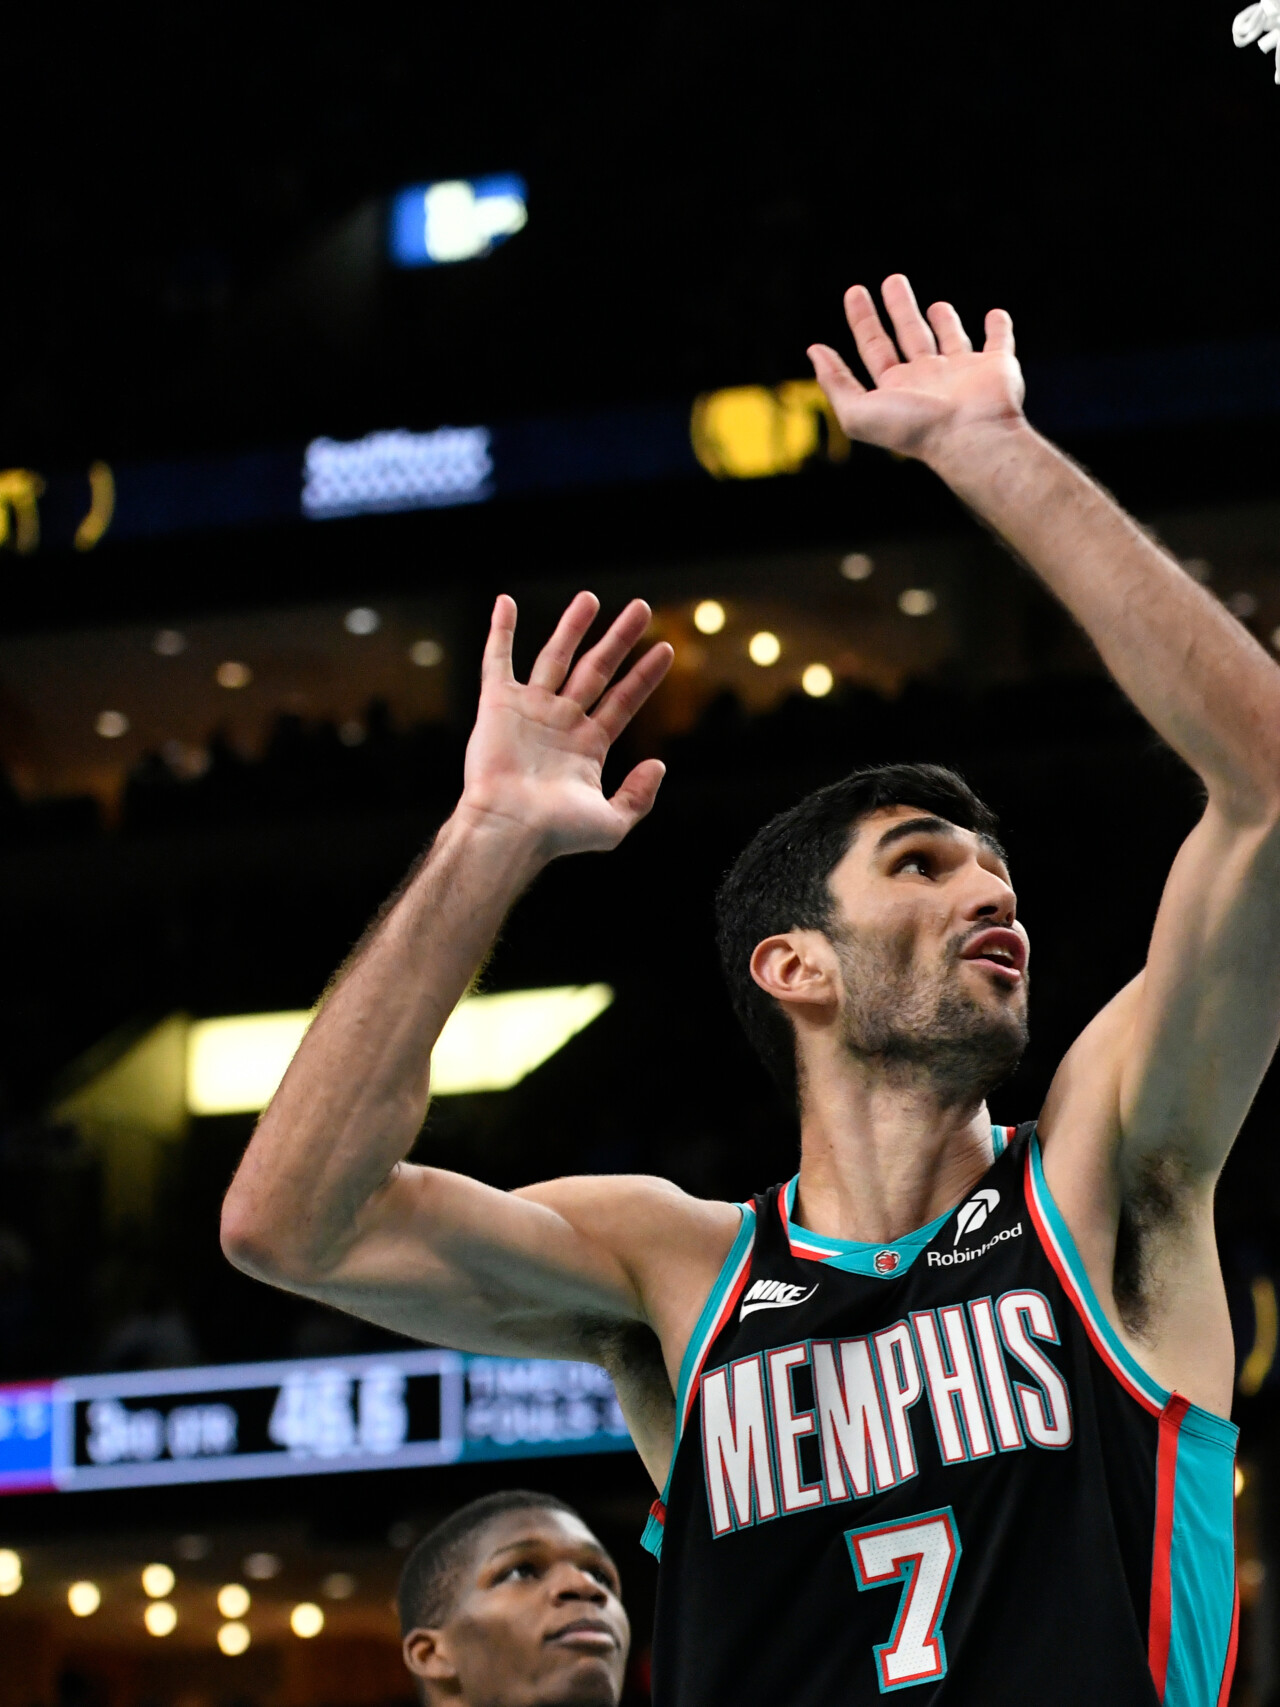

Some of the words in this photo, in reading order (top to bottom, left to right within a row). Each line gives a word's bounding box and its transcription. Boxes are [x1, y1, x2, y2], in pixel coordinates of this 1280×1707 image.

[744, 1279, 807, 1302] NIKE
[926, 1222, 1023, 1267] Robinhood
[700, 1288, 1074, 1540] MEMPHIS
[843, 1506, 963, 1694] 7
